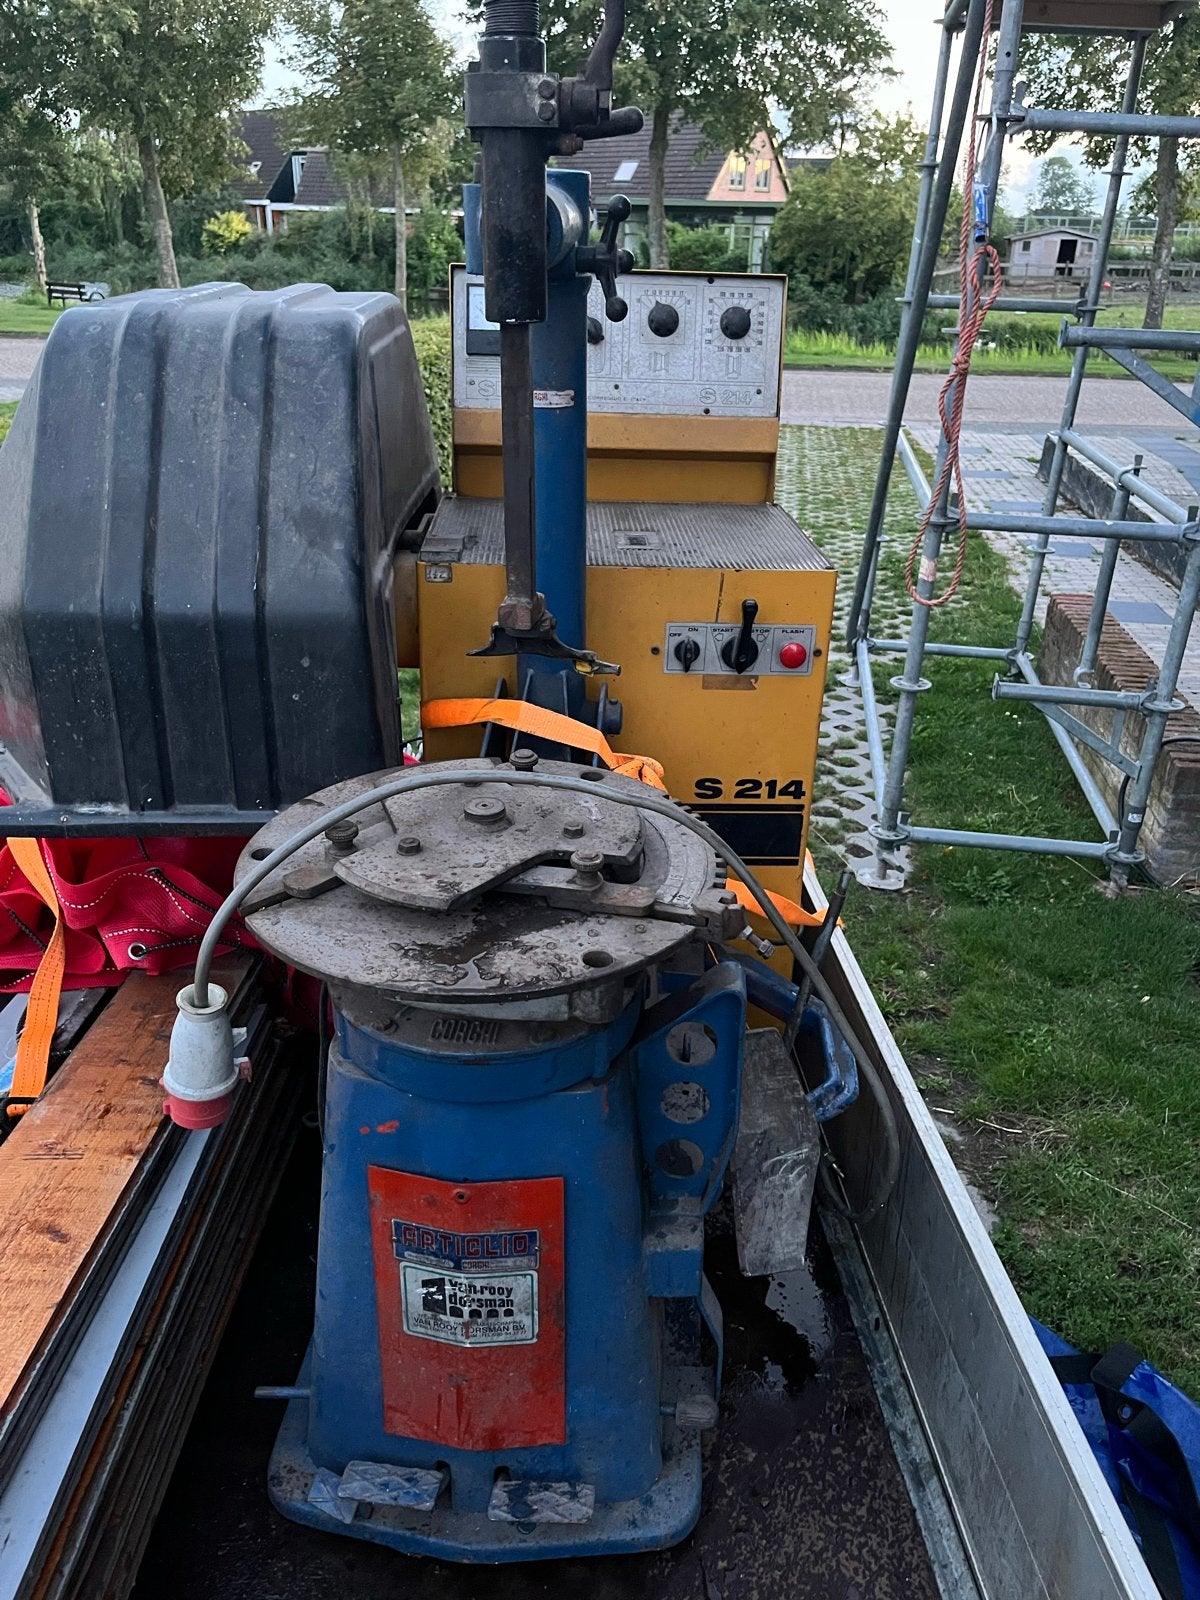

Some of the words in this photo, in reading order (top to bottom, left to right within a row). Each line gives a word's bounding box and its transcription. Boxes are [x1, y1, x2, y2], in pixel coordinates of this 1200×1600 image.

[722, 389, 752, 406] 214
[694, 777, 723, 800] S
[733, 778, 806, 800] 214
[429, 1018, 500, 1046] CORGHI
[402, 1225, 529, 1257] ARTIGLIO
[448, 1292, 514, 1309] dorsman
[480, 1285, 514, 1299] rooy
[413, 1316, 431, 1327] VAN
[433, 1321, 458, 1331] ROOY
